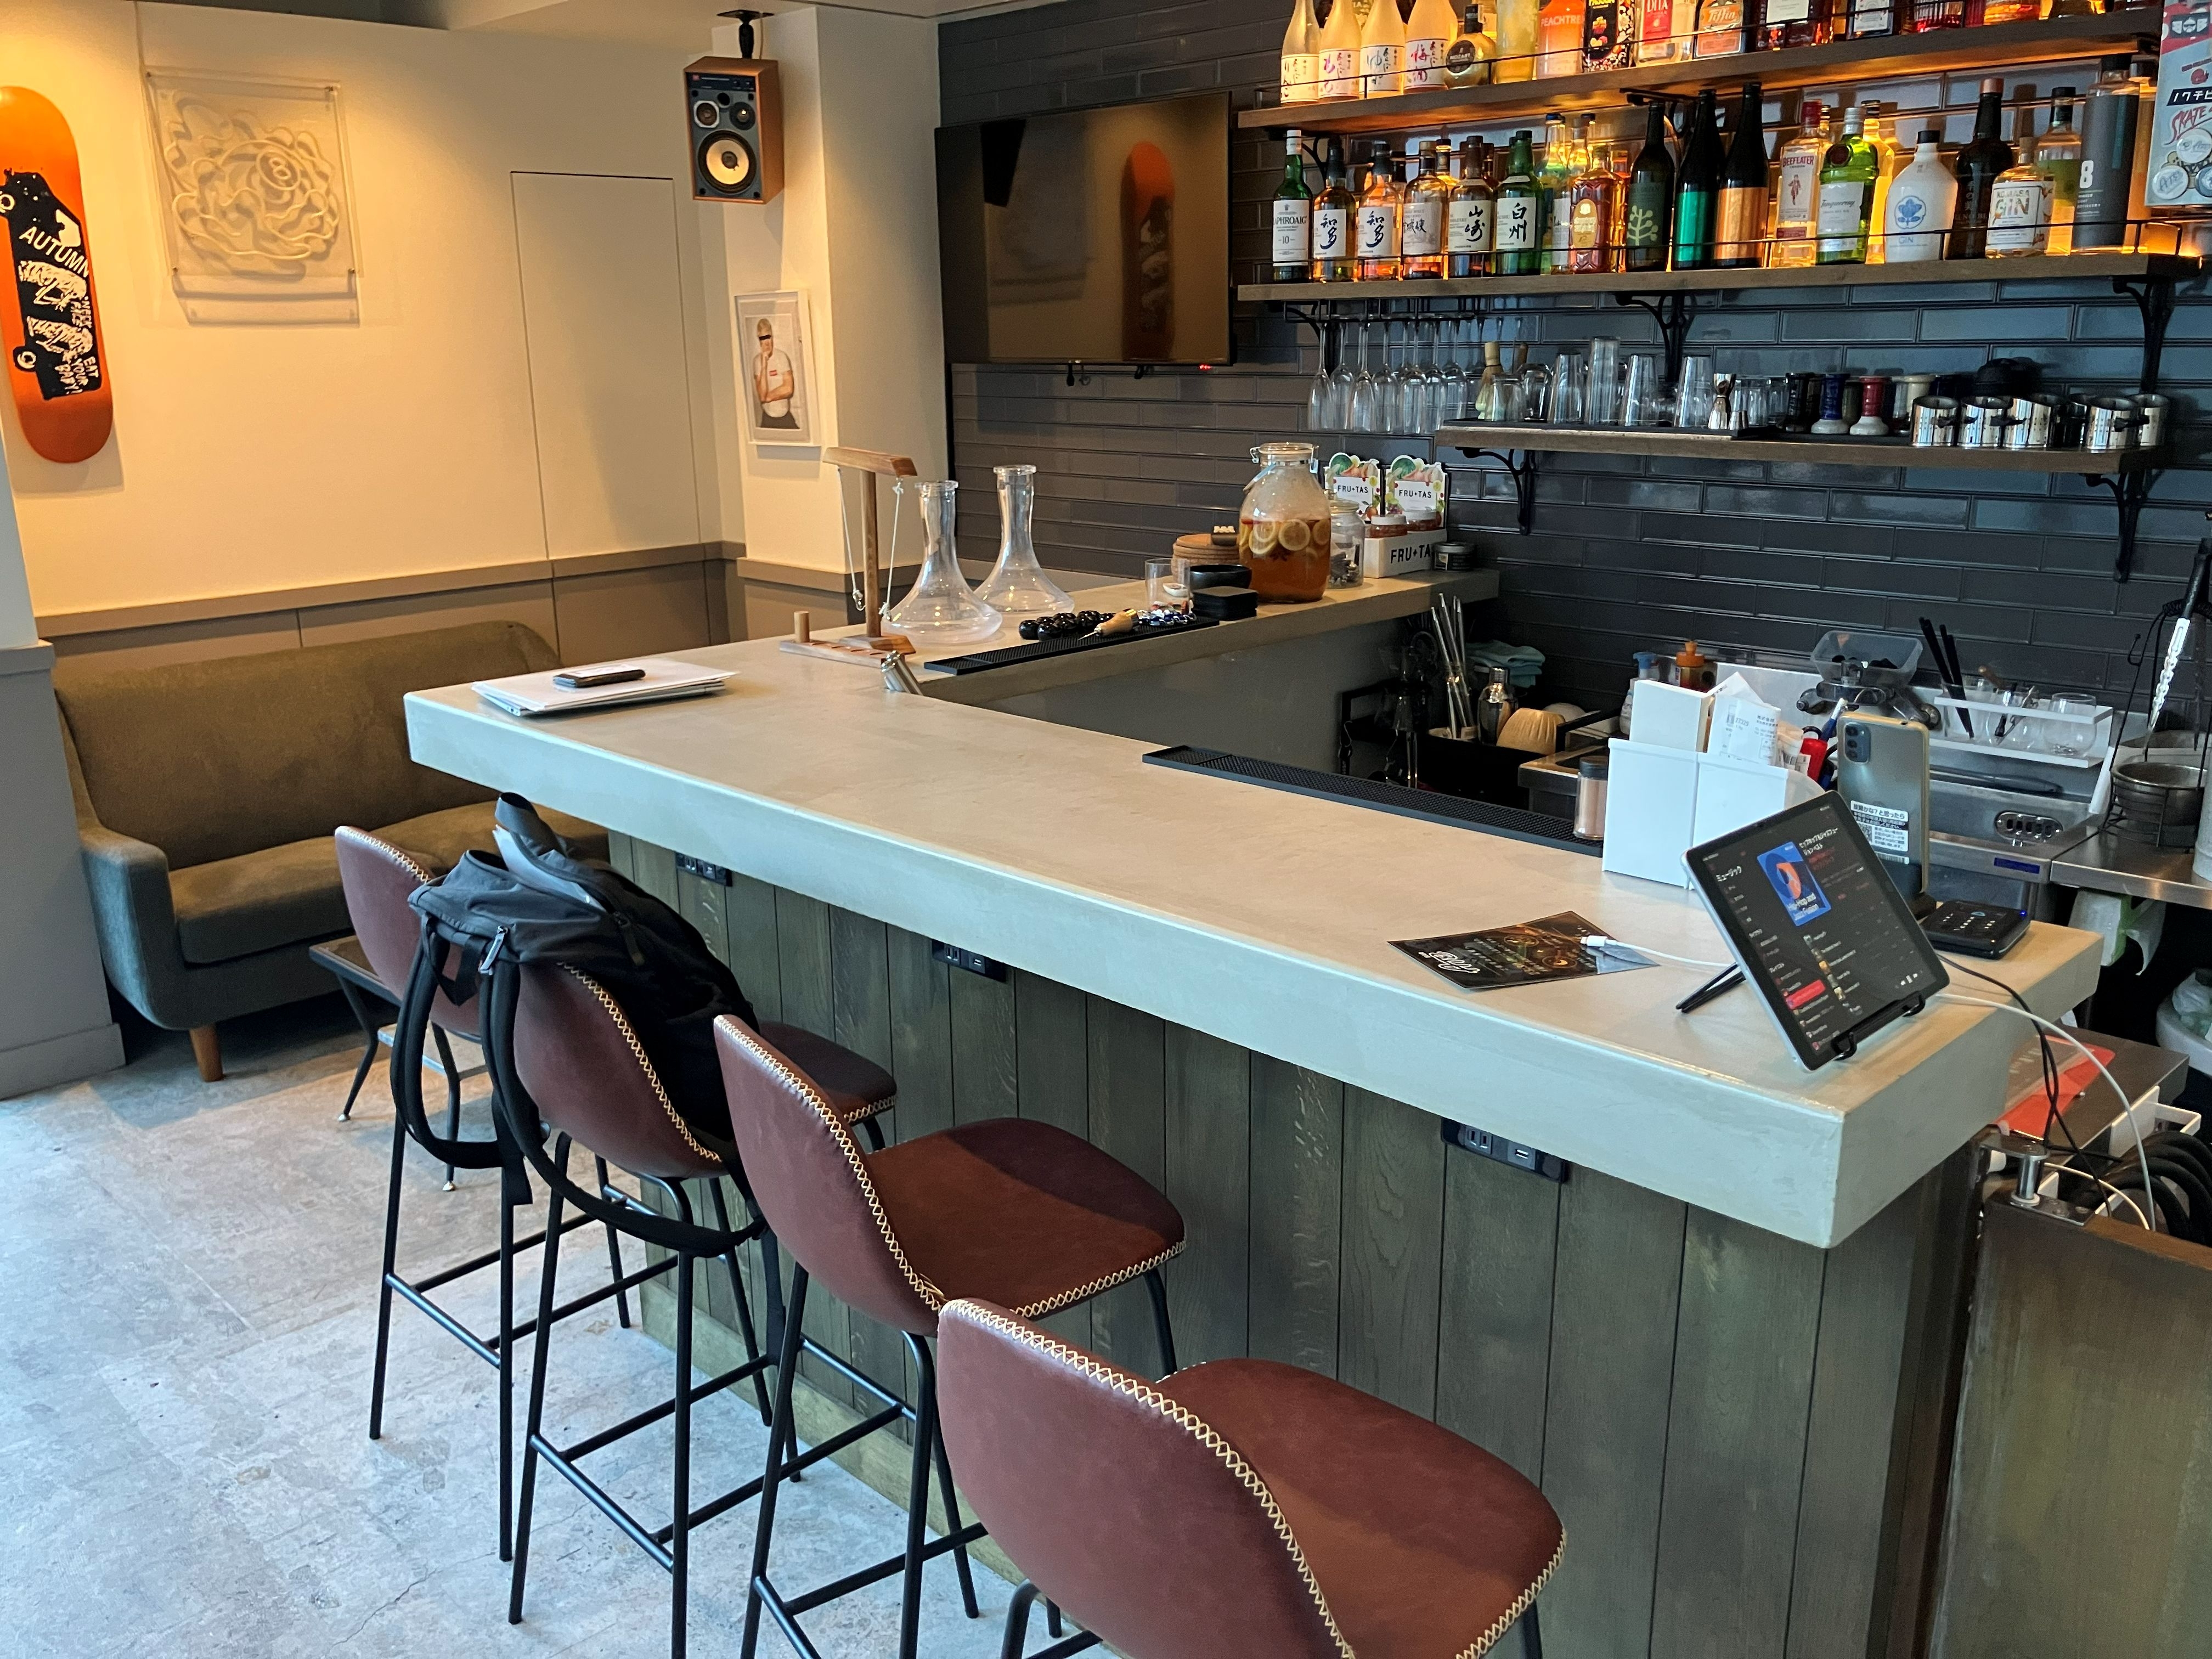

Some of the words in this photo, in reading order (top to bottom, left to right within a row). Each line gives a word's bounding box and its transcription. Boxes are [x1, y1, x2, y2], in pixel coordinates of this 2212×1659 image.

[1541, 15, 1584, 27] PEACHTRE
[1707, 8, 1736, 22] Tiffin
[1782, 156, 1814, 167] BEEFEATER
[1820, 200, 1855, 208] Tanqueray
[1996, 198, 2030, 216] GIN
[1274, 216, 1307, 225] APHROAIG
[1365, 211, 1385, 248] 知多
[1465, 206, 1486, 242] 山崎
[1509, 202, 1527, 242] 白州
[1320, 213, 1338, 250] 知多
[19, 225, 89, 278] AUTUMN
